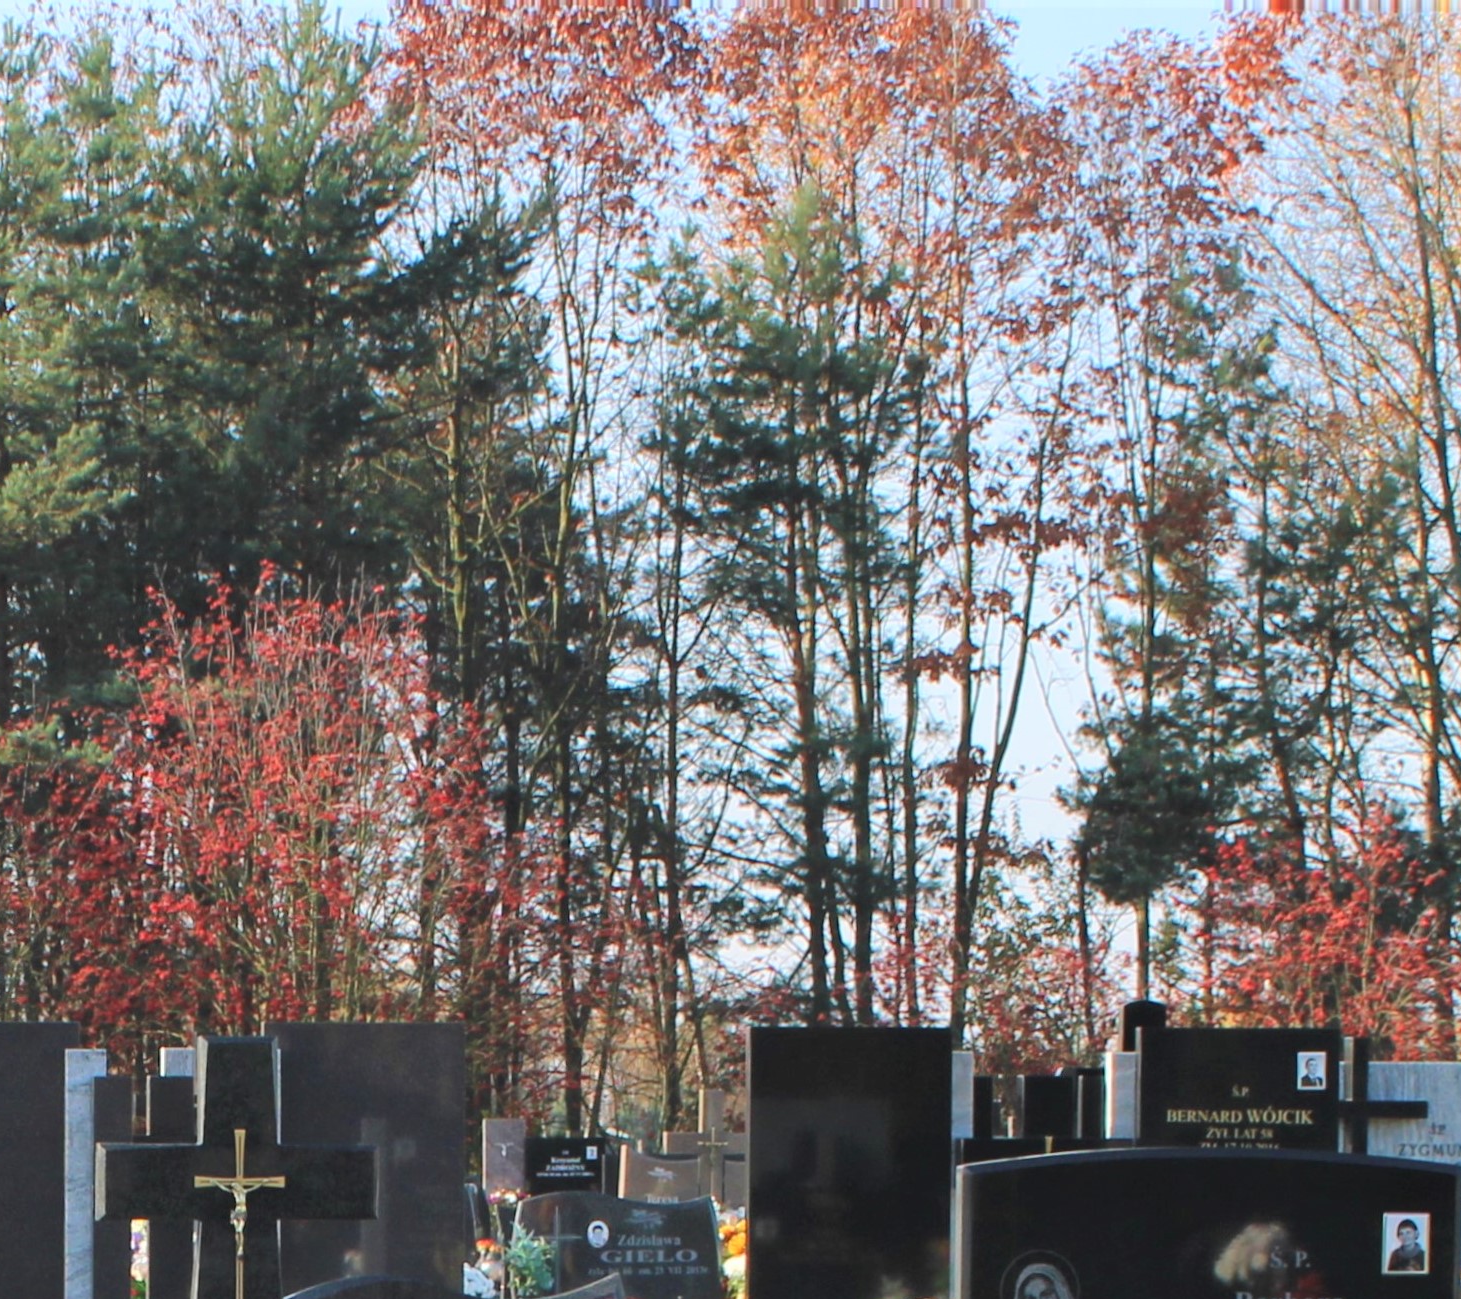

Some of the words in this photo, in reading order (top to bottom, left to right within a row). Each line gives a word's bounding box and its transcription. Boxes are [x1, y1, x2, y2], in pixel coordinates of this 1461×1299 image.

[1166, 1108, 1243, 1124] BERNARD
[1246, 1105, 1314, 1125] WÓJCIK
[1233, 1127, 1257, 1140] LAT
[1294, 1250, 1312, 1269] P.
